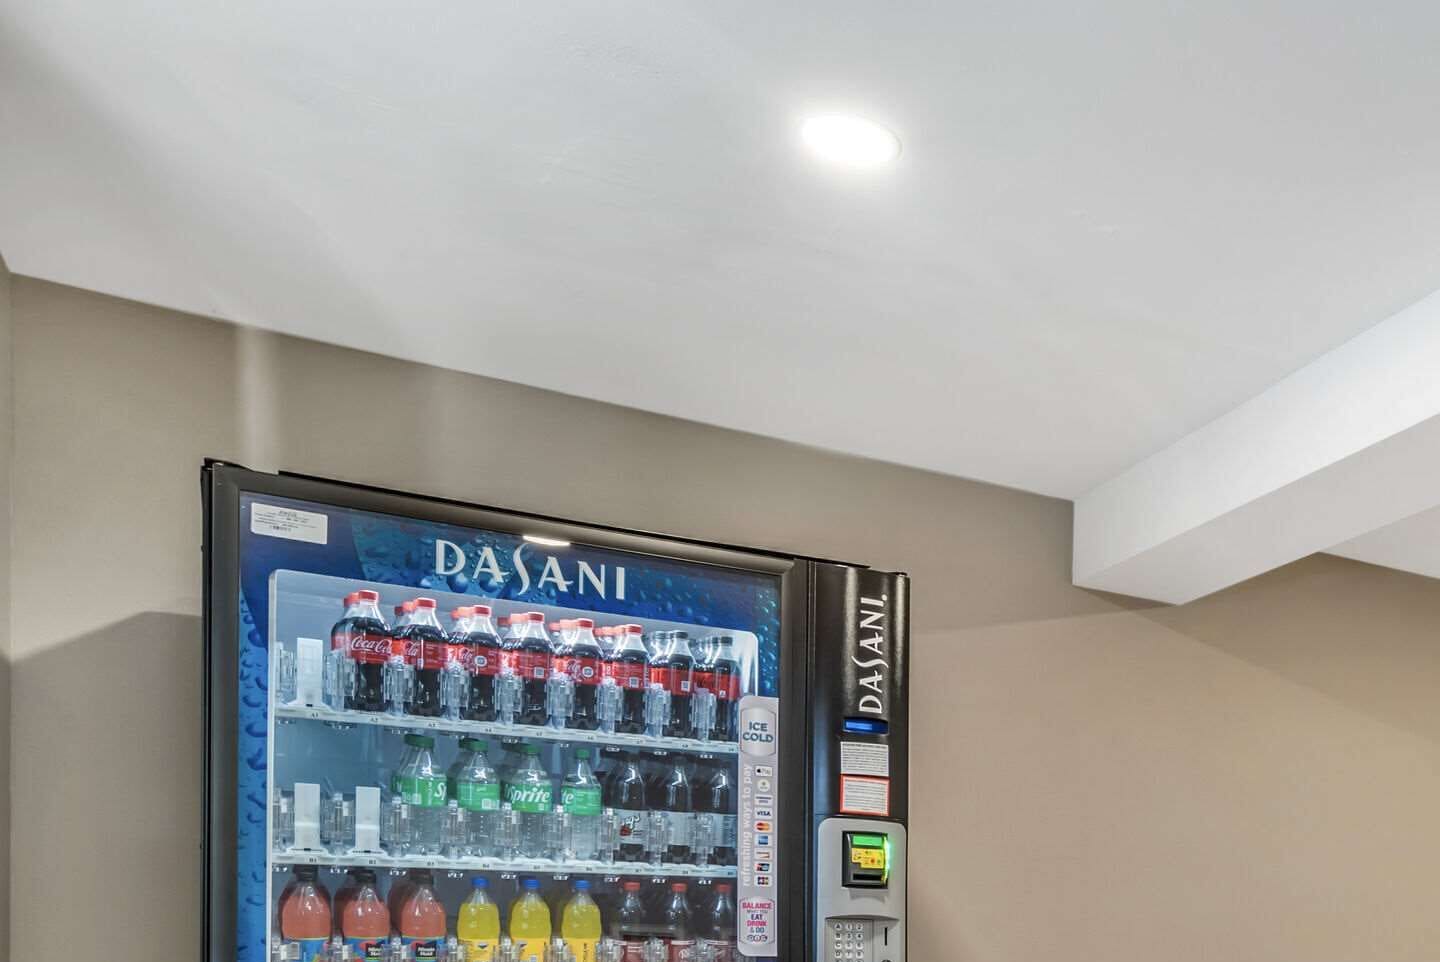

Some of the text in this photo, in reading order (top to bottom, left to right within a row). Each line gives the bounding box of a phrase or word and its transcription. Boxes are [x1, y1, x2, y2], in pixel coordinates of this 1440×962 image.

[435, 540, 625, 600] DASANI
[750, 722, 768, 731] ICE
[742, 732, 773, 743] COLD
